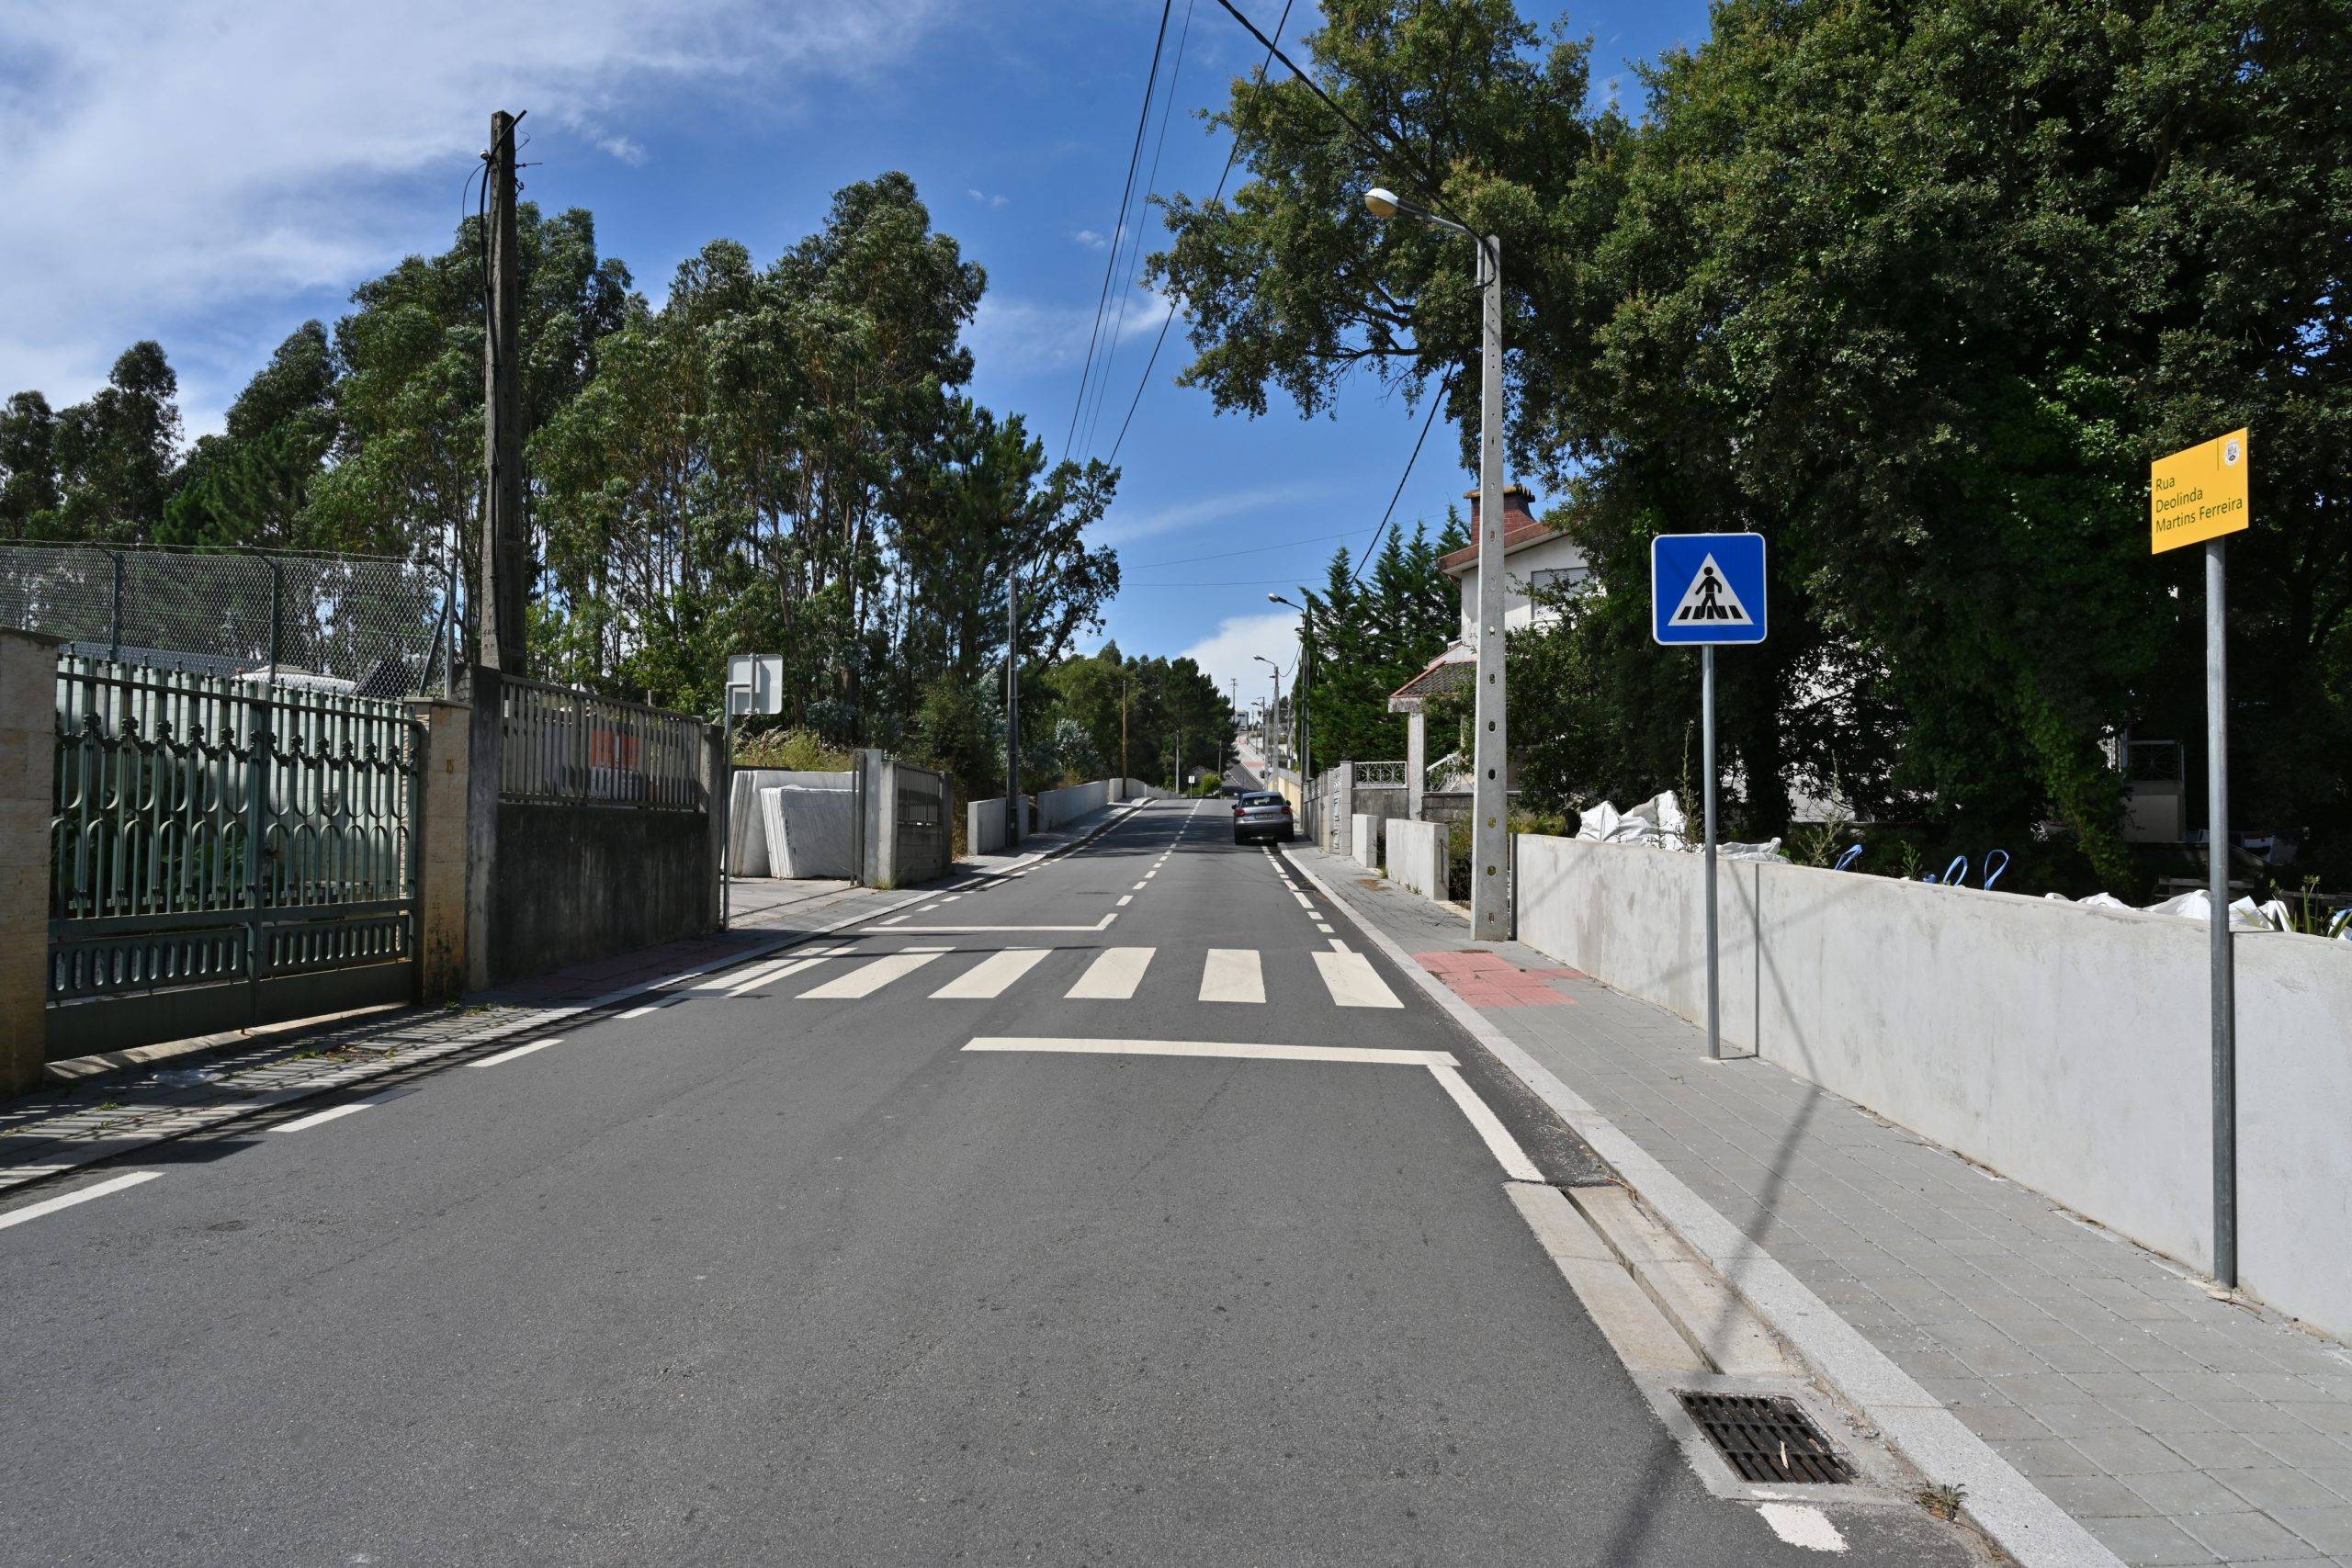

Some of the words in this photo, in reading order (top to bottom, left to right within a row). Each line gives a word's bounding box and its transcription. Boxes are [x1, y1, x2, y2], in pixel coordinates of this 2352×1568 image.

[2155, 477, 2176, 492] Rua
[2155, 487, 2203, 513] Deolinda
[2155, 512, 2196, 534] Martins
[2199, 497, 2243, 521] Ferreira
